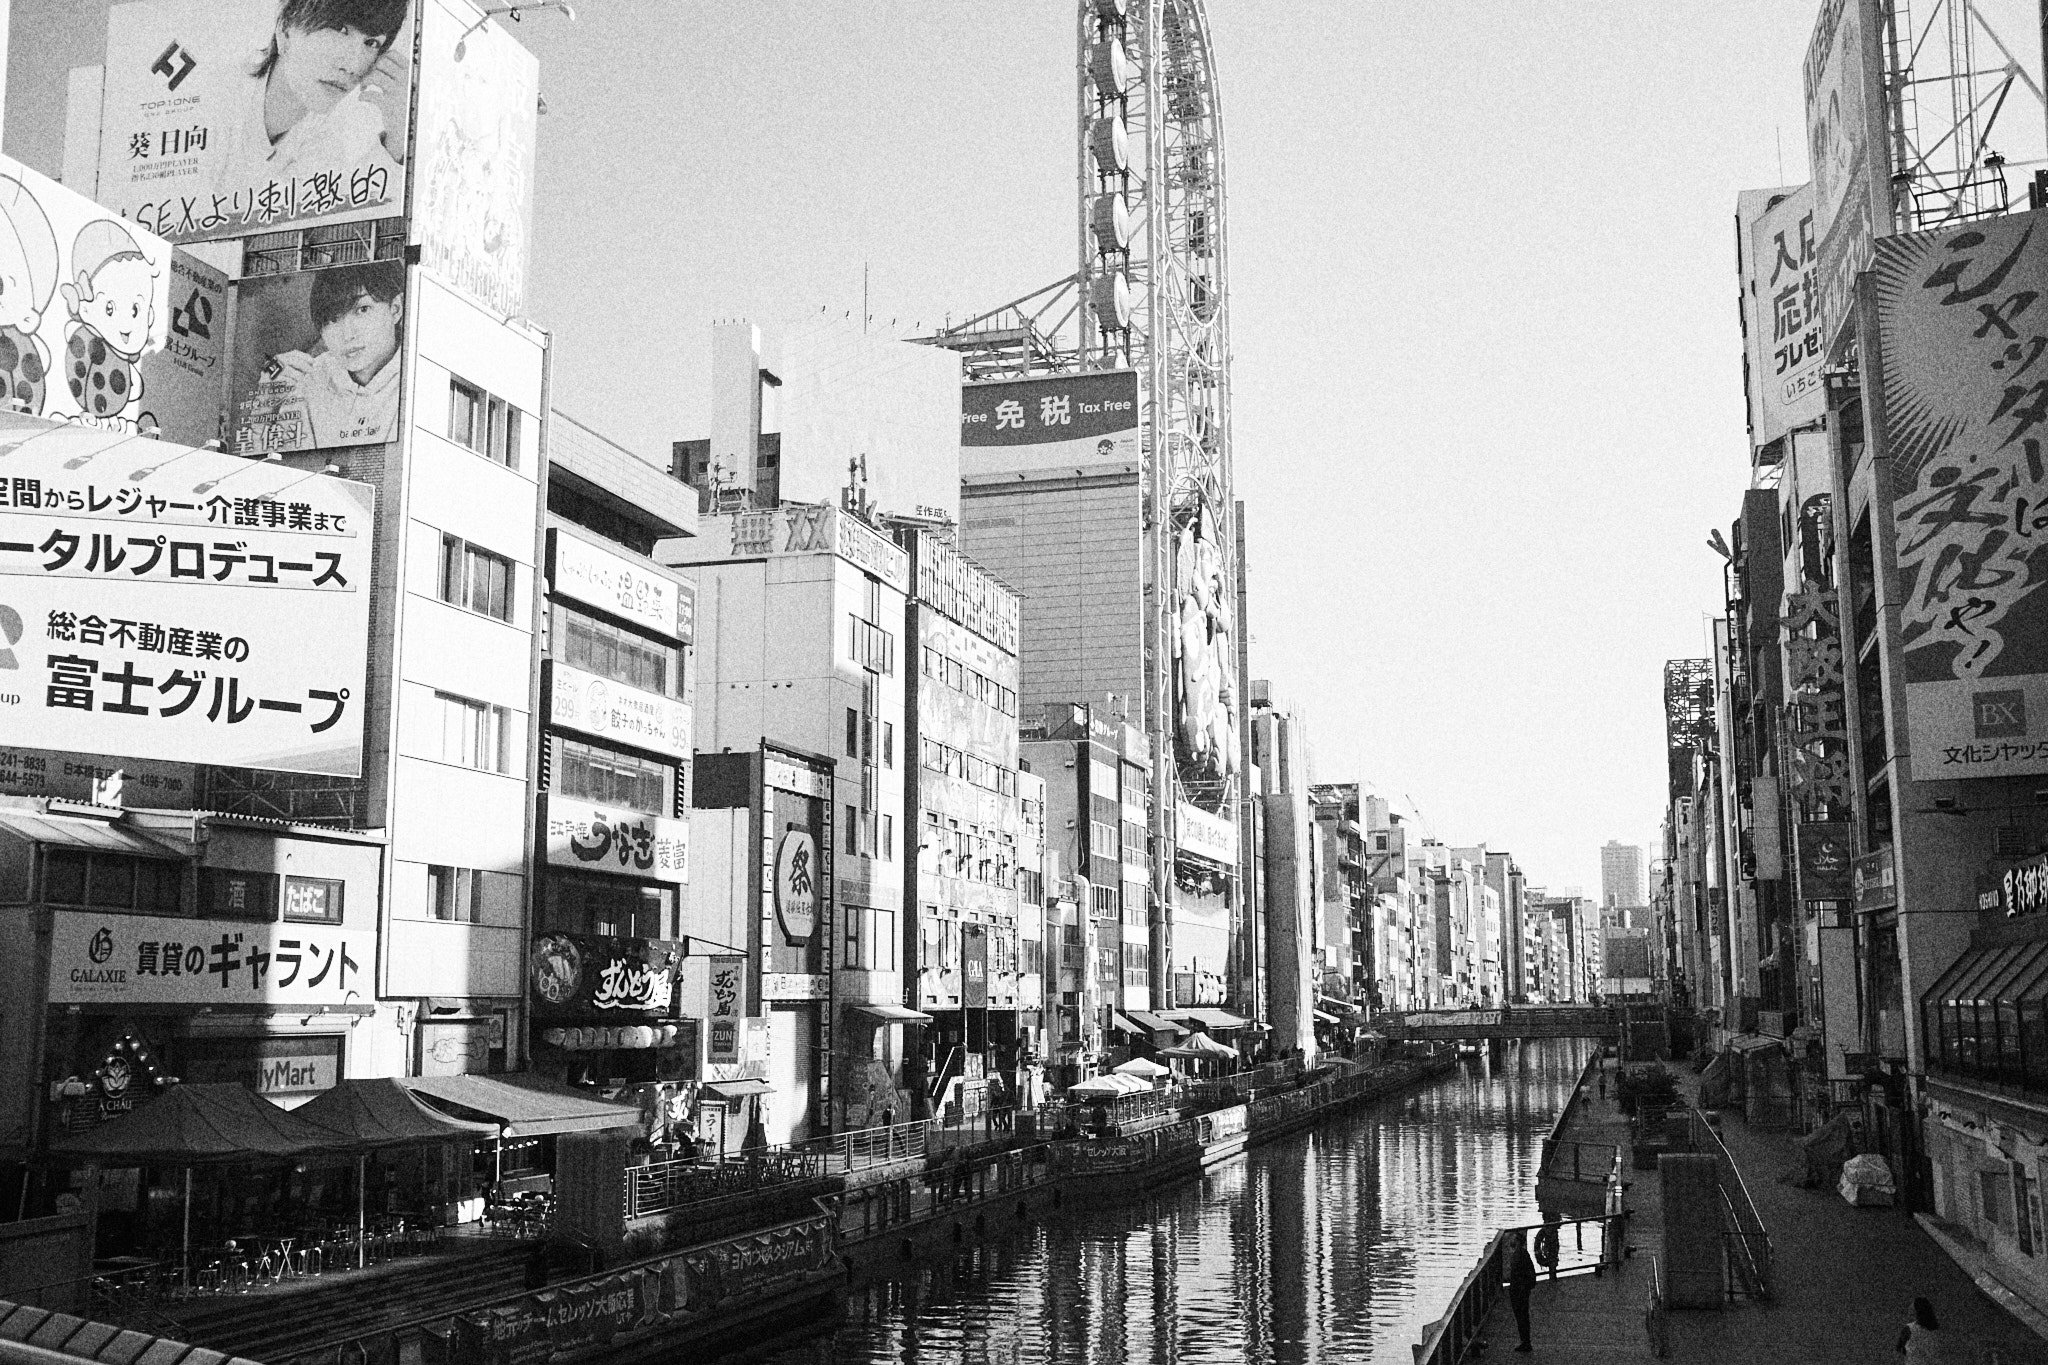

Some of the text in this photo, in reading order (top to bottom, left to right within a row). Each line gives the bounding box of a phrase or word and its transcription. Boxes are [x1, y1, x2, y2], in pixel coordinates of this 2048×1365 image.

[136, 164, 388, 236] SEXより刺激的
[1774, 327, 1823, 376] プレゼ
[994, 394, 1072, 431] 免税
[1078, 400, 1132, 414] Tax Free
[0, 477, 347, 533] 間からレジャー・介護事業まで
[47, 610, 250, 663] 総合不動産業の
[46, 654, 350, 734] 富士グループ
[570, 811, 656, 870] うなぎ
[788, 840, 815, 897] 祭
[286, 885, 324, 915] たばこ
[70, 968, 127, 984] GALAXIE
[137, 933, 359, 990] 賃貸のギャラント
[713, 1029, 733, 1042] ZUN
[705, 1113, 717, 1142] ラーメ
